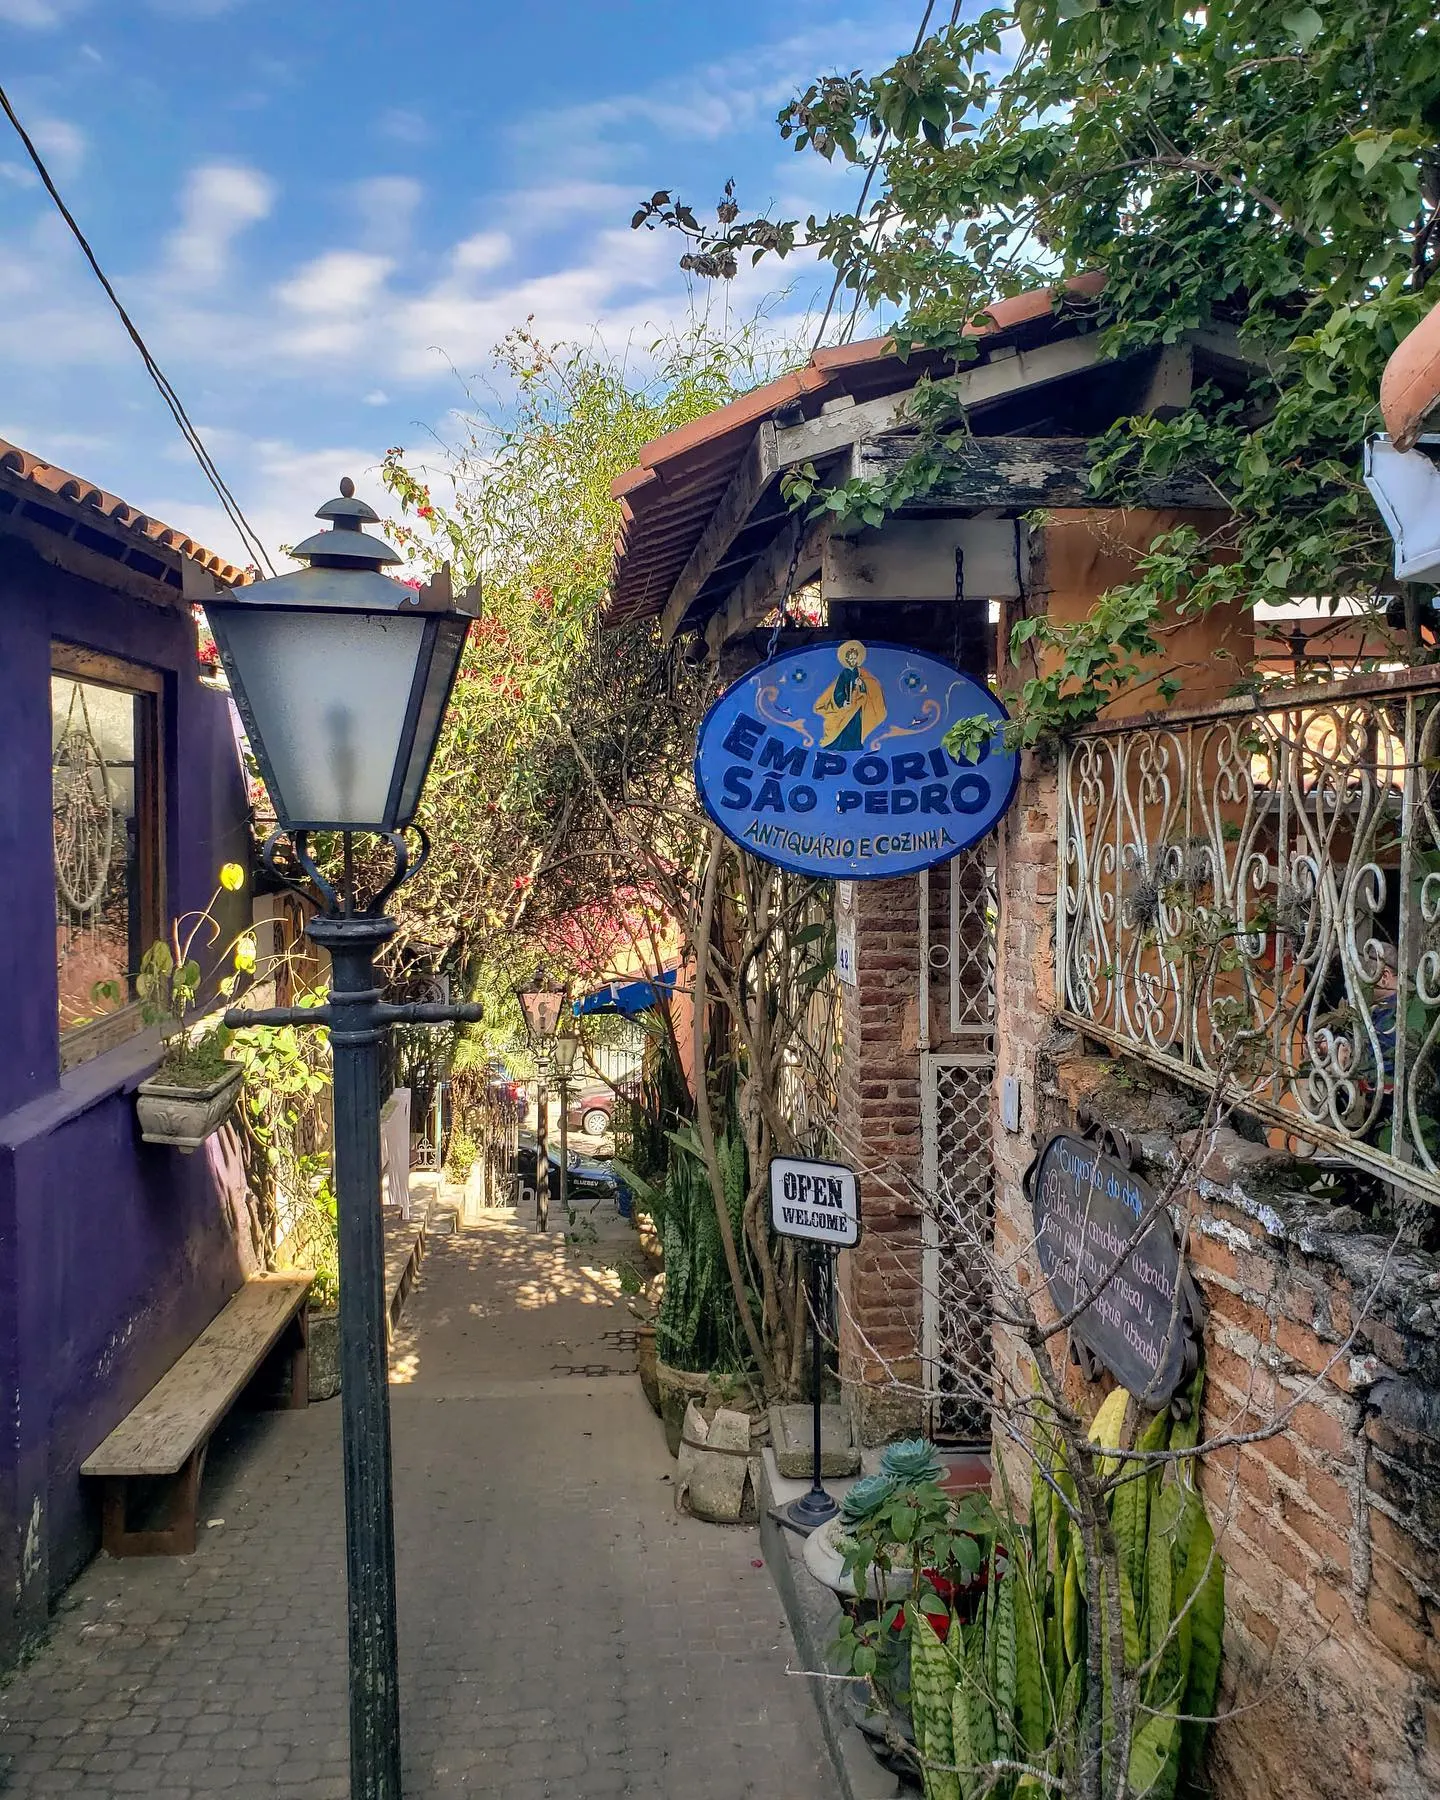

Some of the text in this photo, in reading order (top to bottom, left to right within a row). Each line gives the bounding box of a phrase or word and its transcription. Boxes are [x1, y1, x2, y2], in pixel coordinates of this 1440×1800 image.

[721, 766, 991, 815] SÃO PEDRO
[744, 820, 956, 858] ANTIQUÁRIO E COZINHA
[784, 1172, 843, 1208] OPEN
[782, 1207, 847, 1232] WELCOME
